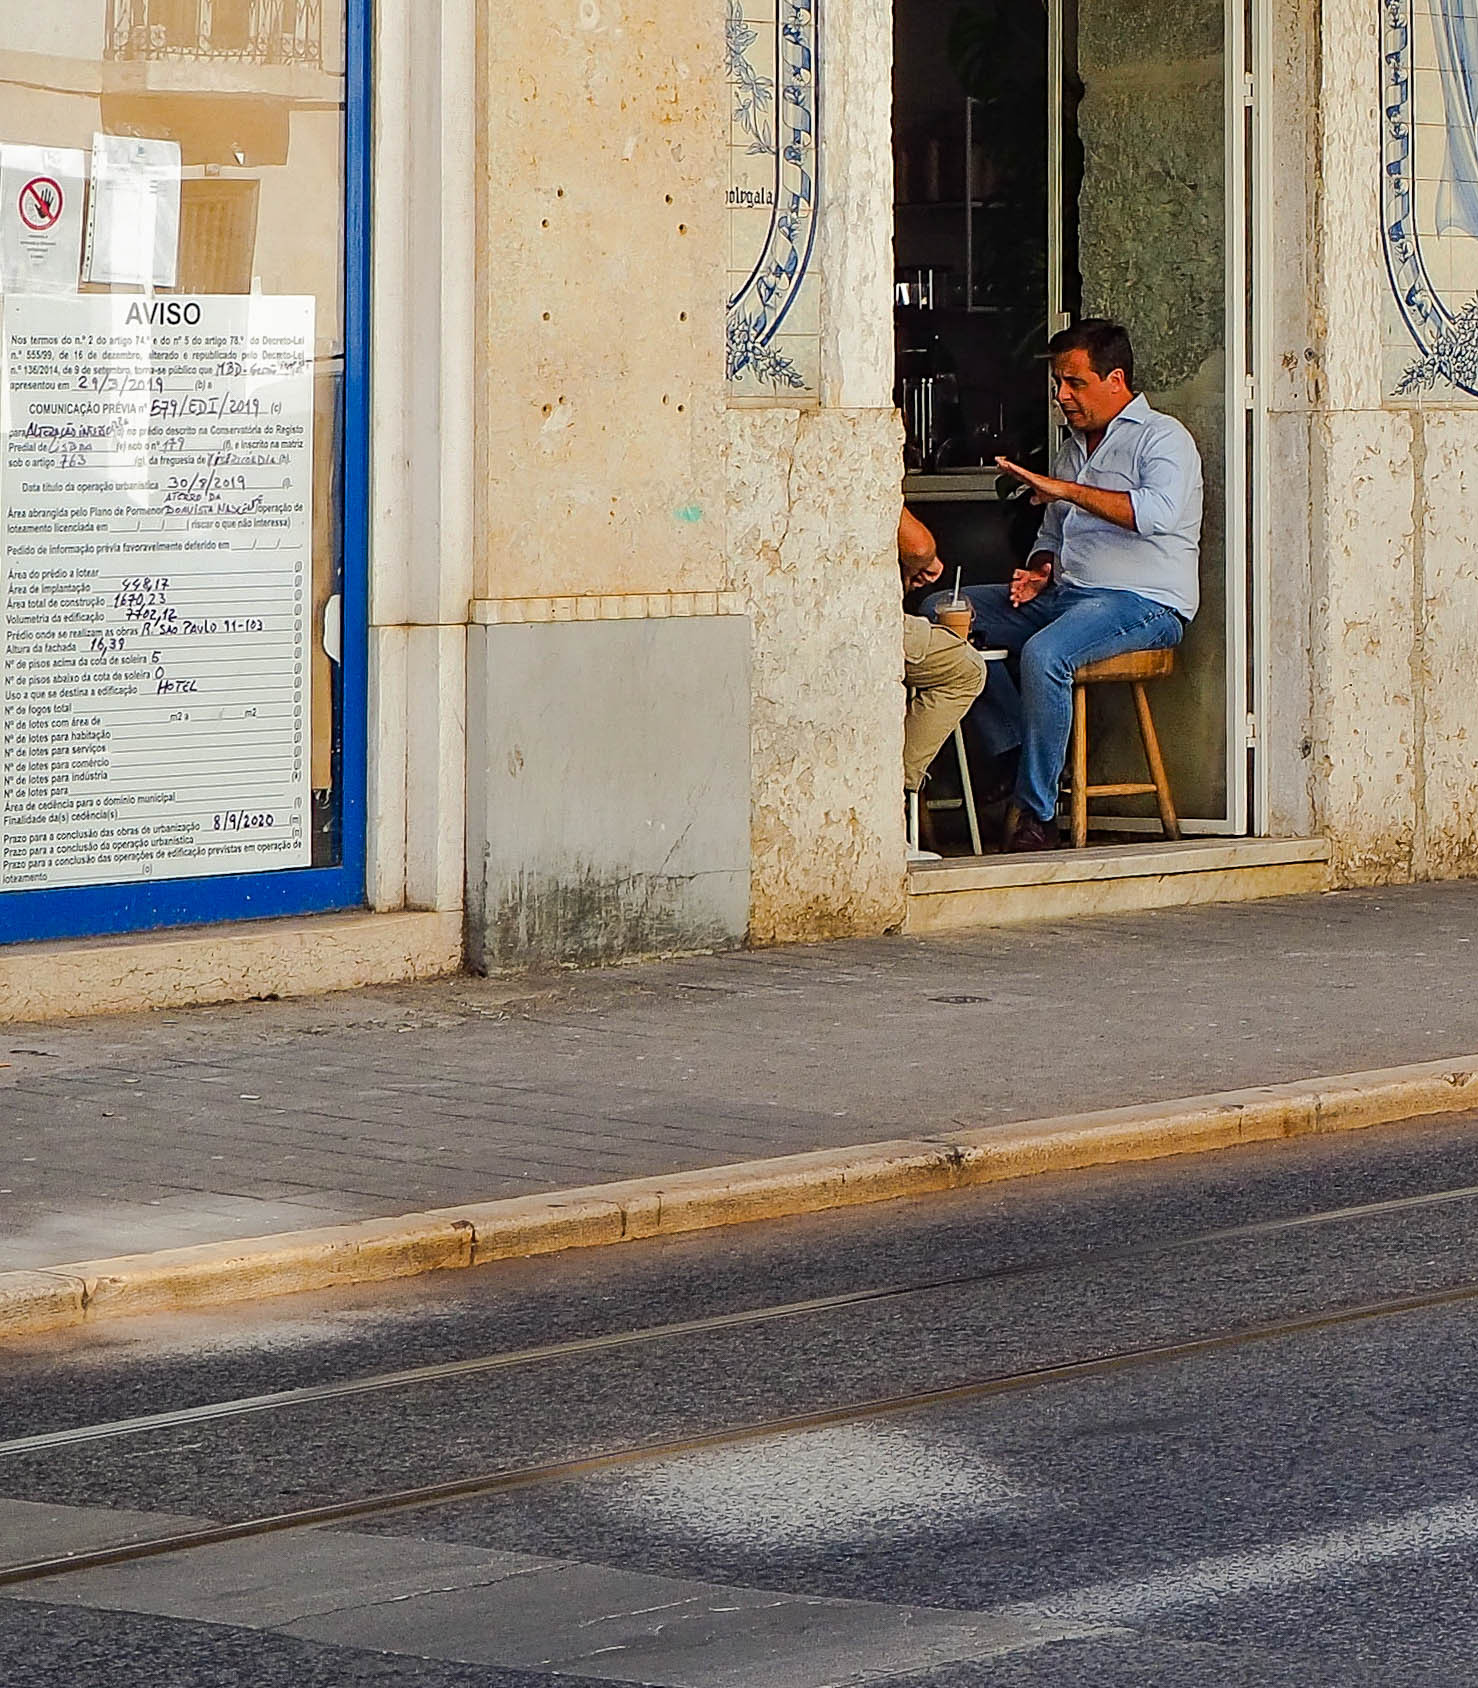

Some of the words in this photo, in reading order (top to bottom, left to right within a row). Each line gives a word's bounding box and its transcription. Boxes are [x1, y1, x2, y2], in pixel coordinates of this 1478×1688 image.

[125, 302, 201, 325] AVISO
[29, 401, 100, 416] COMUNICAÇÃO
[157, 679, 198, 695] HOTEL
[213, 809, 274, 832] 8/9/2020
